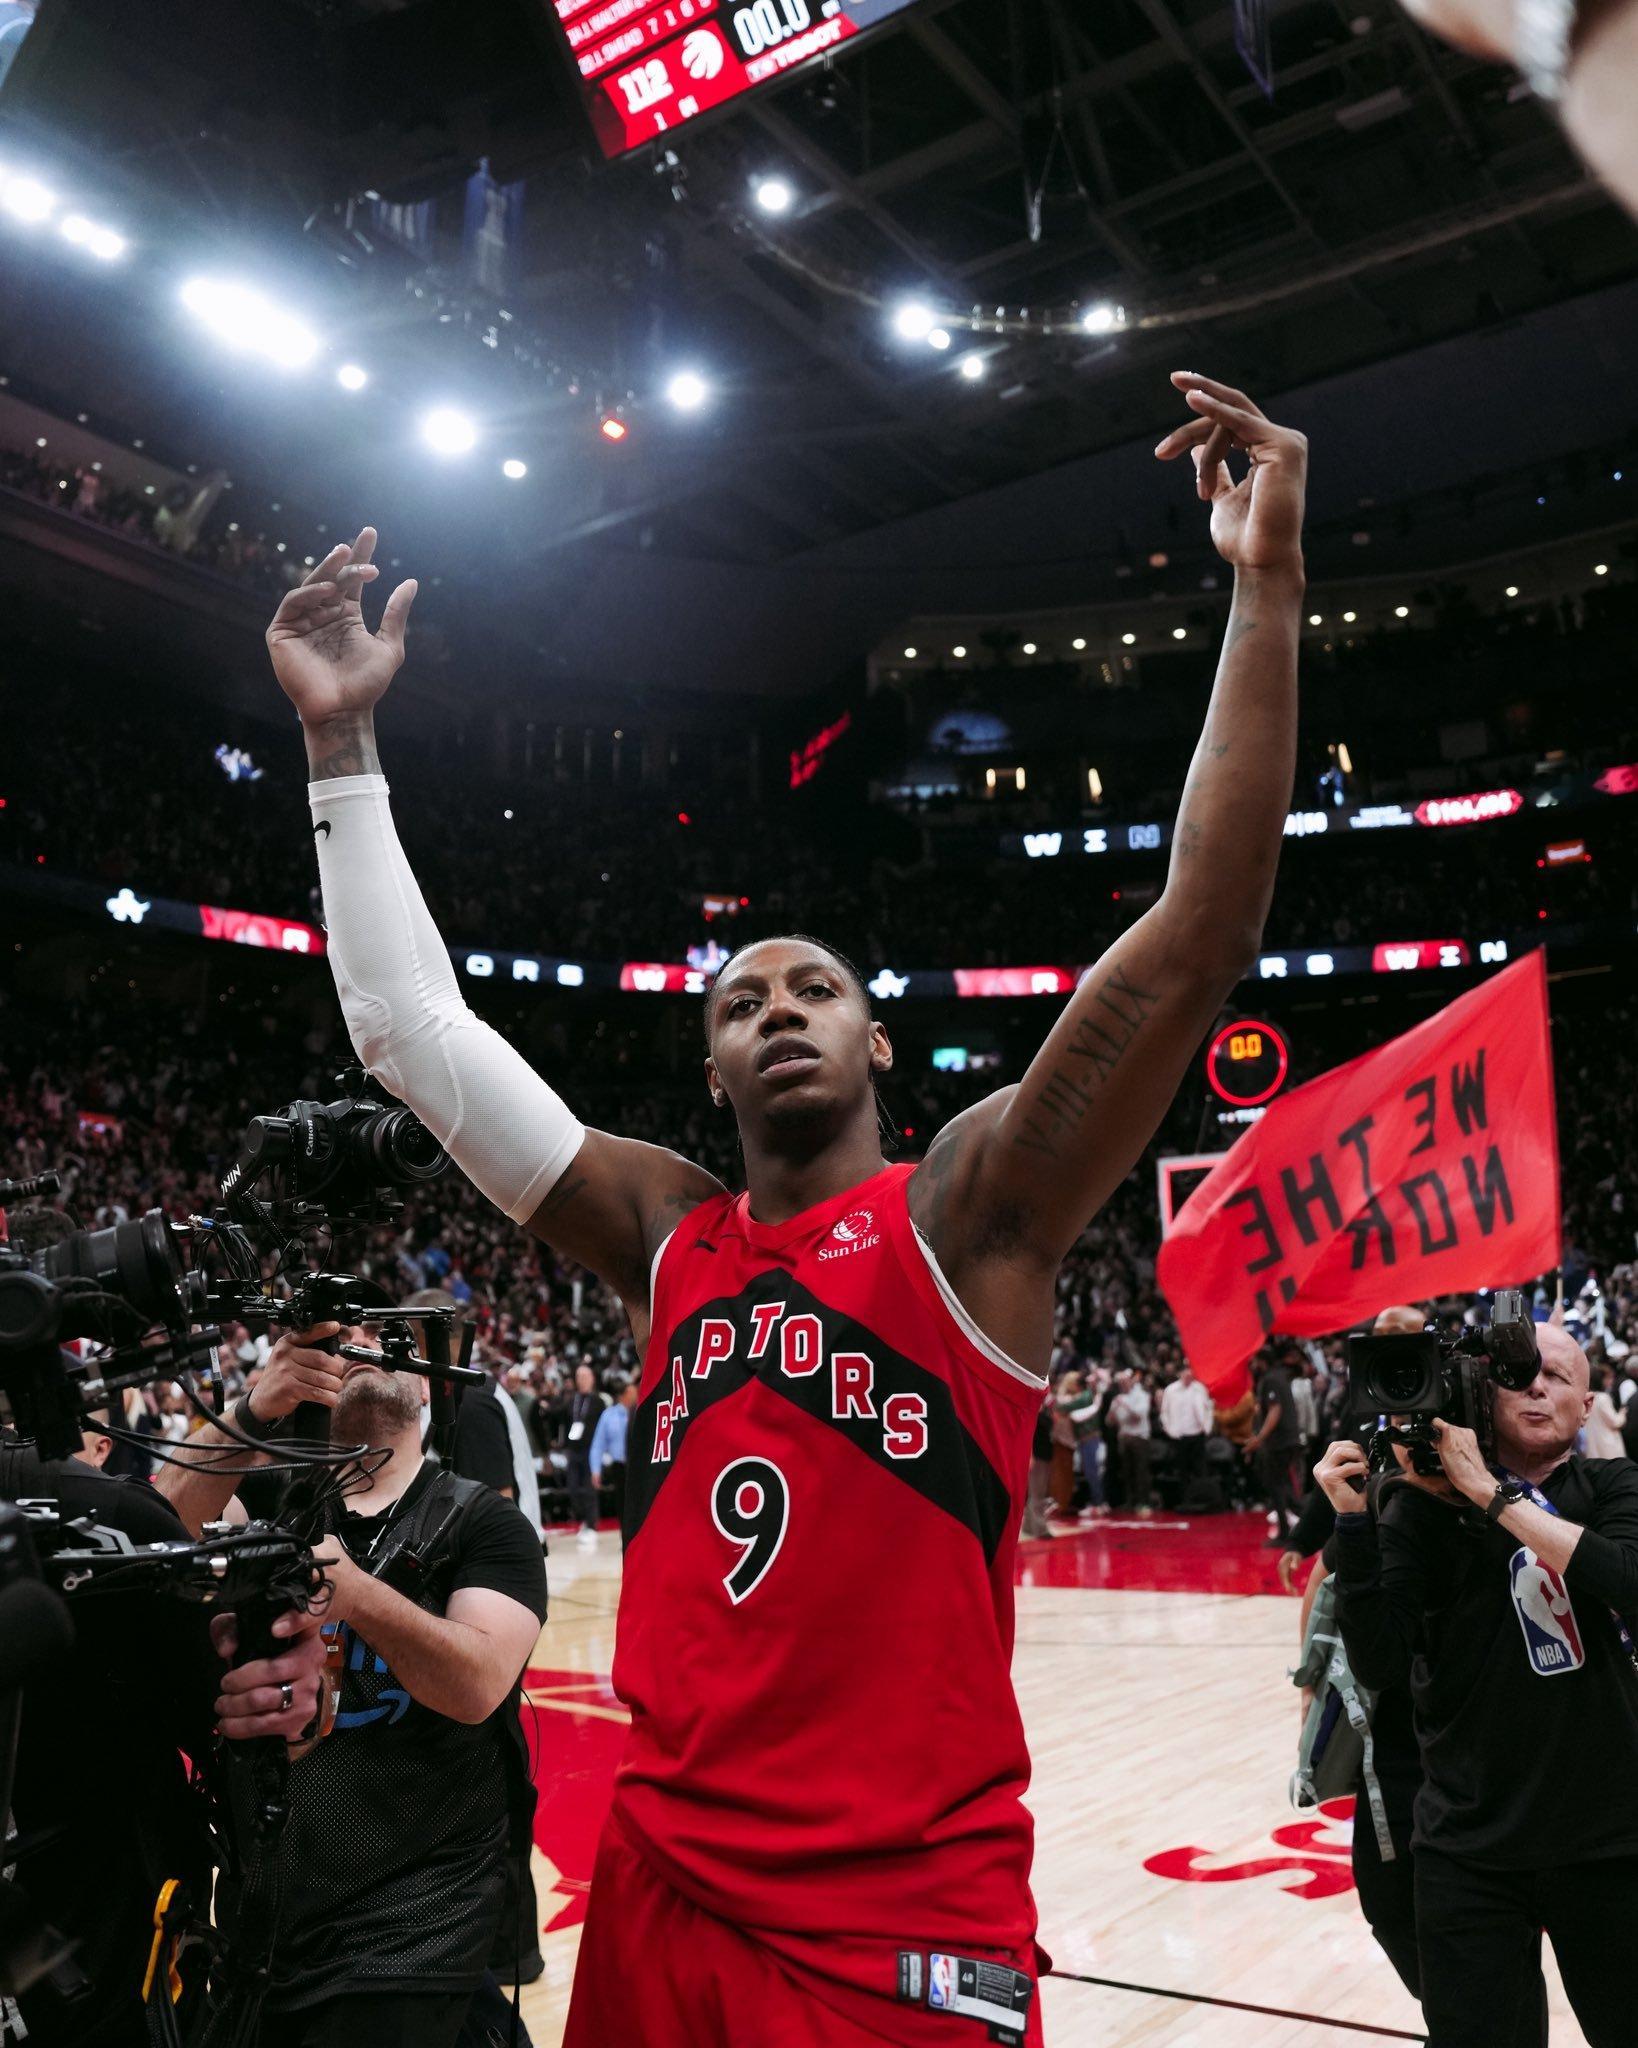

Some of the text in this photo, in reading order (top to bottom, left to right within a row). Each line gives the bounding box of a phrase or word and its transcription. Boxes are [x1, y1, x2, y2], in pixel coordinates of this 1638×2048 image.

[617, 58, 675, 115] 112
[354, 1102, 376, 1111] Canon
[305, 1119, 314, 1157] Canon
[818, 1233, 880, 1261] Sun Life
[651, 1301, 929, 1463] RAPTORS
[711, 1455, 790, 1606] 9
[1535, 1642, 1566, 1668] NBA
